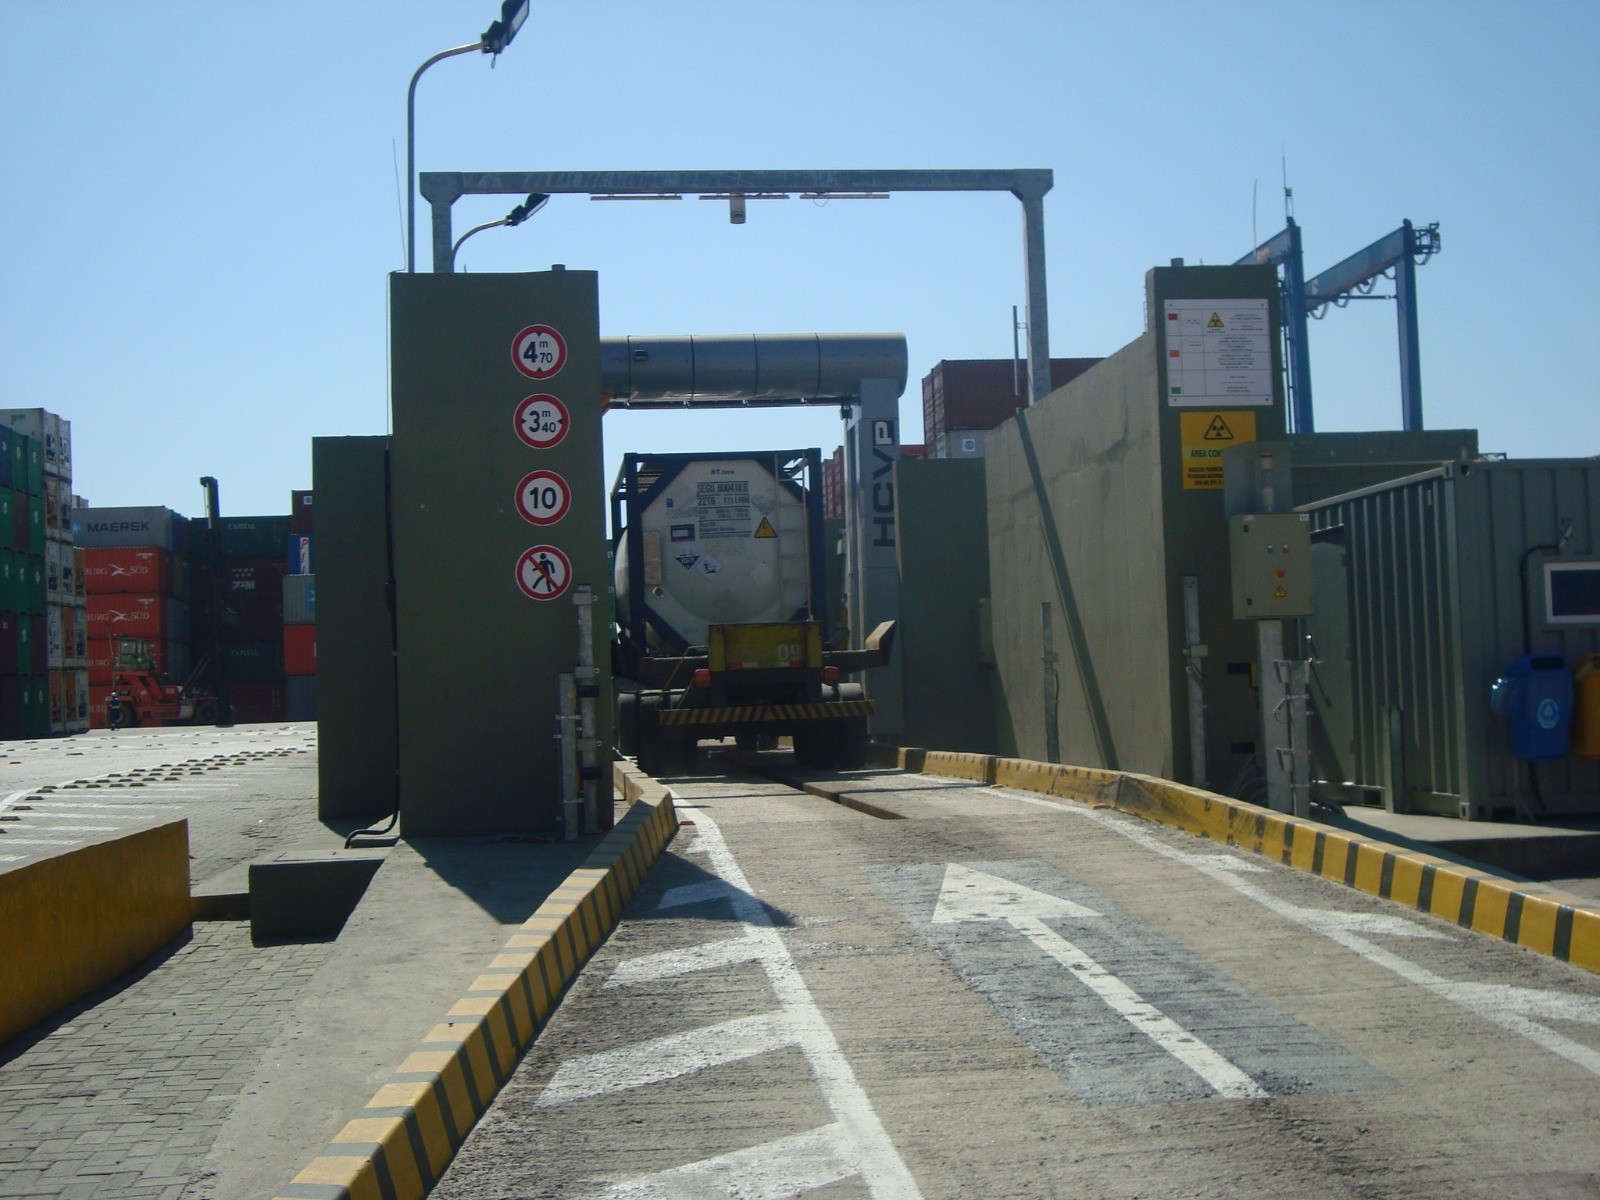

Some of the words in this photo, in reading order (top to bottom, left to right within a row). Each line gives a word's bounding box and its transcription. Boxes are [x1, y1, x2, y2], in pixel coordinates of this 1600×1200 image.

[539, 340, 549, 348] m
[523, 341, 538, 363] 4
[540, 352, 554, 363] 70
[542, 410, 551, 418] m
[528, 410, 541, 433] 3
[541, 422, 556, 433] 40
[1208, 449, 1223, 457] CON
[697, 483, 715, 494] SEGU
[873, 420, 895, 547] HCVP
[529, 487, 557, 510] 10
[698, 497, 716, 506] 22T6
[88, 521, 151, 533] MAERSK
[130, 565, 149, 575] SÜD
[130, 611, 150, 620] SÜD
[778, 644, 801, 660] 09
